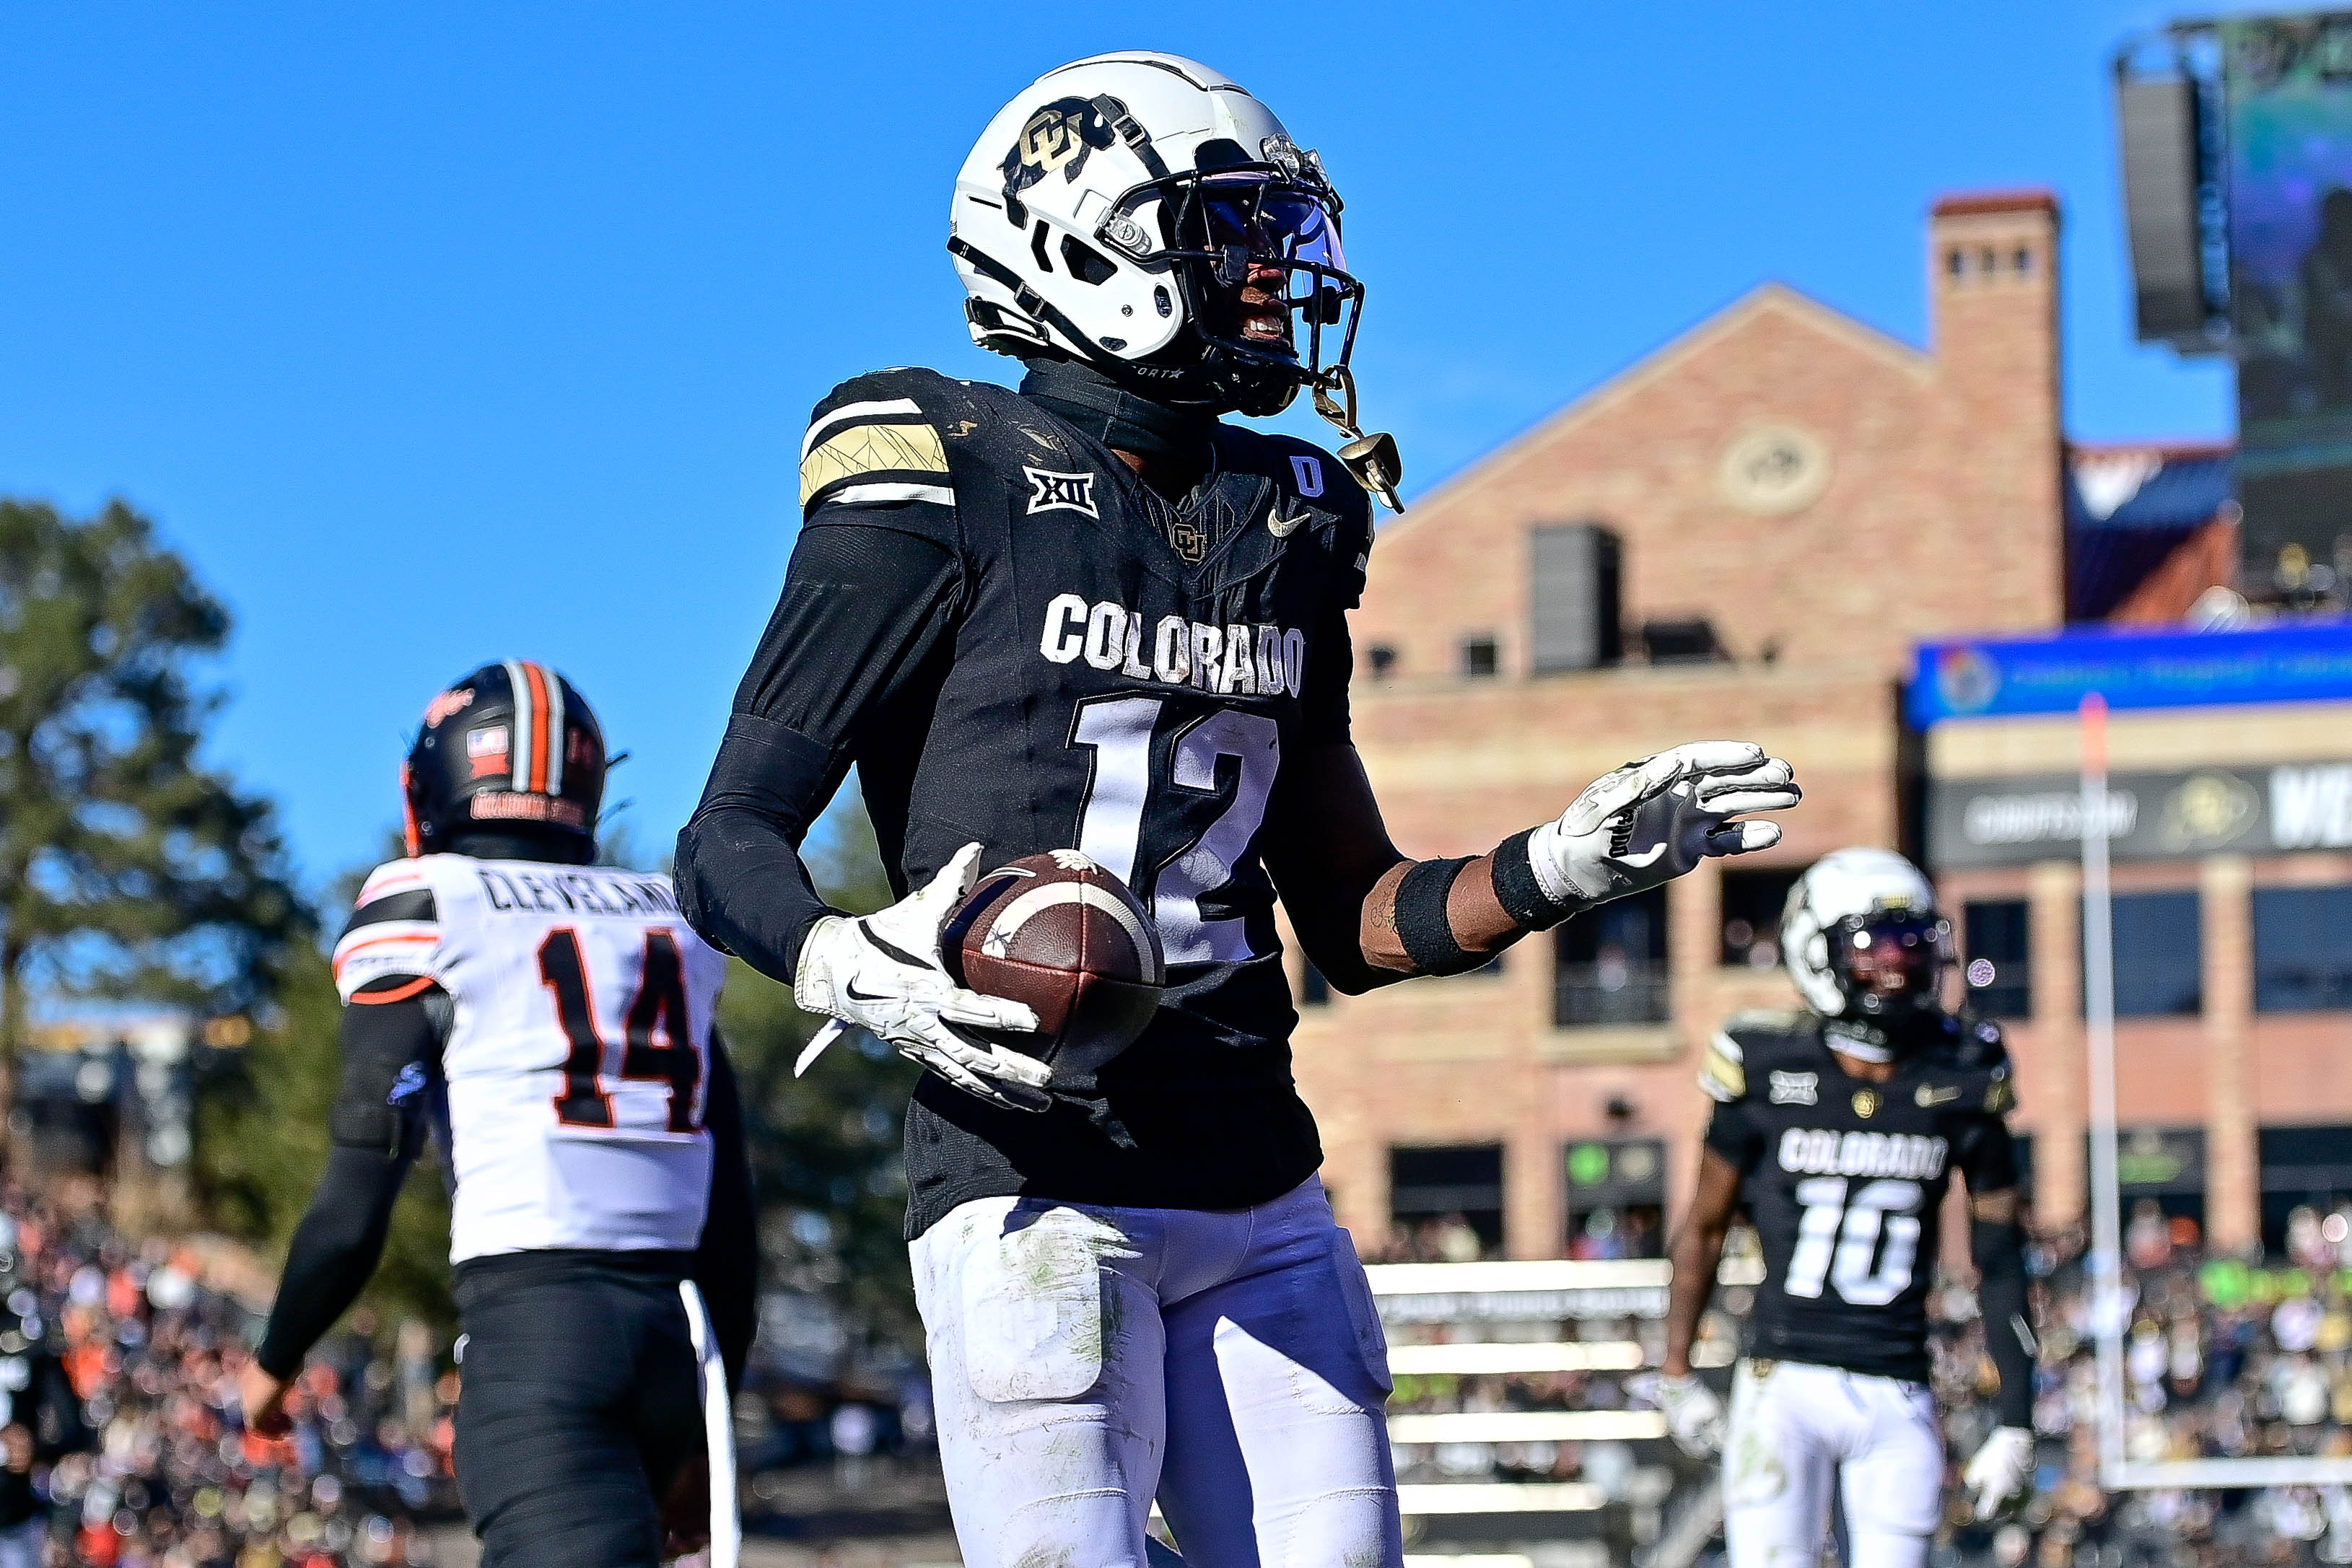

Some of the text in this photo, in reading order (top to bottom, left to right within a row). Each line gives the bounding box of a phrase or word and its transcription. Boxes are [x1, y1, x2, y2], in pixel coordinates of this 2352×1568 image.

[1039, 592, 1304, 699] COLORADO
[1072, 696, 1280, 964] 12
[536, 927, 699, 1131] 14
[1778, 1127, 1949, 1180] COLORADO
[1784, 1175, 1925, 1306] 10
